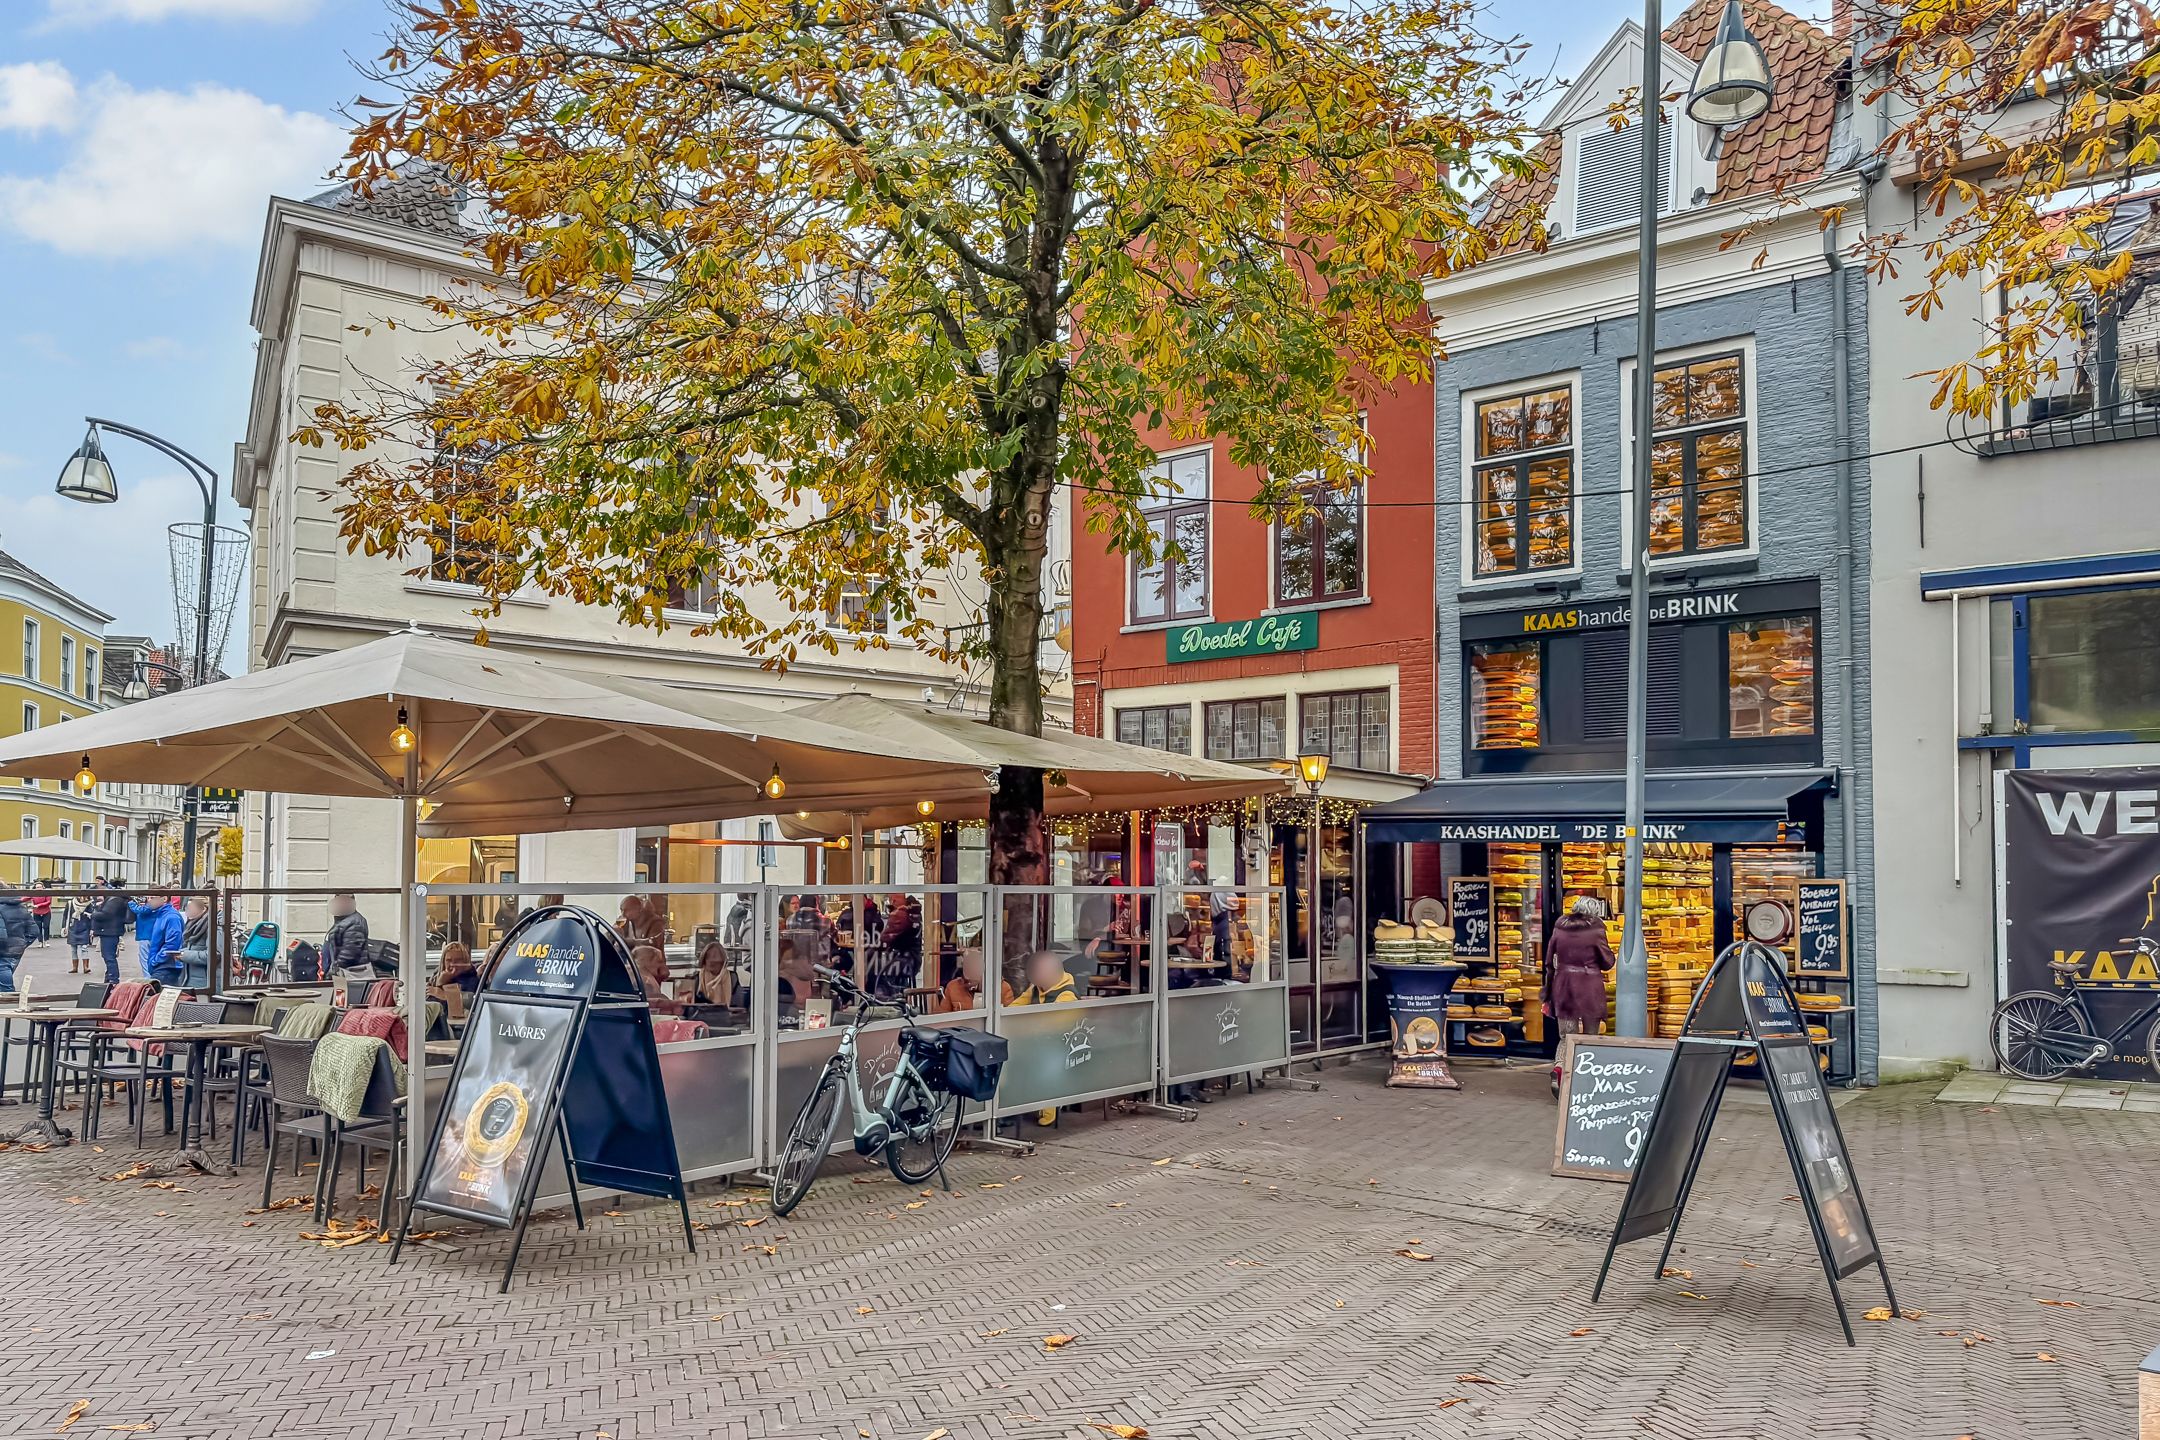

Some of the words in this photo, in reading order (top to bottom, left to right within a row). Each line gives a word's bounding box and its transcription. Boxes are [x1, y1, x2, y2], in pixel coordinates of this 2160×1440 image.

[1523, 605, 1632, 632] KAAShande
[1650, 608, 1666, 620] DE
[1667, 593, 1739, 618] BRINK
[1179, 620, 1253, 653] Doedel
[1256, 616, 1302, 651] Café
[1441, 826, 1560, 839] KAASHANDEL
[1615, 824, 1685, 838] BINK"
[1458, 892, 1479, 901] KAAS
[1800, 887, 1838, 899] BOEREN
[535, 959, 544, 967] DE
[541, 960, 582, 977] BRINK
[498, 1023, 547, 1040] LANGRES
[1575, 1051, 1654, 1076] BOEREN-
[1590, 1077, 1638, 1094] KAAS
